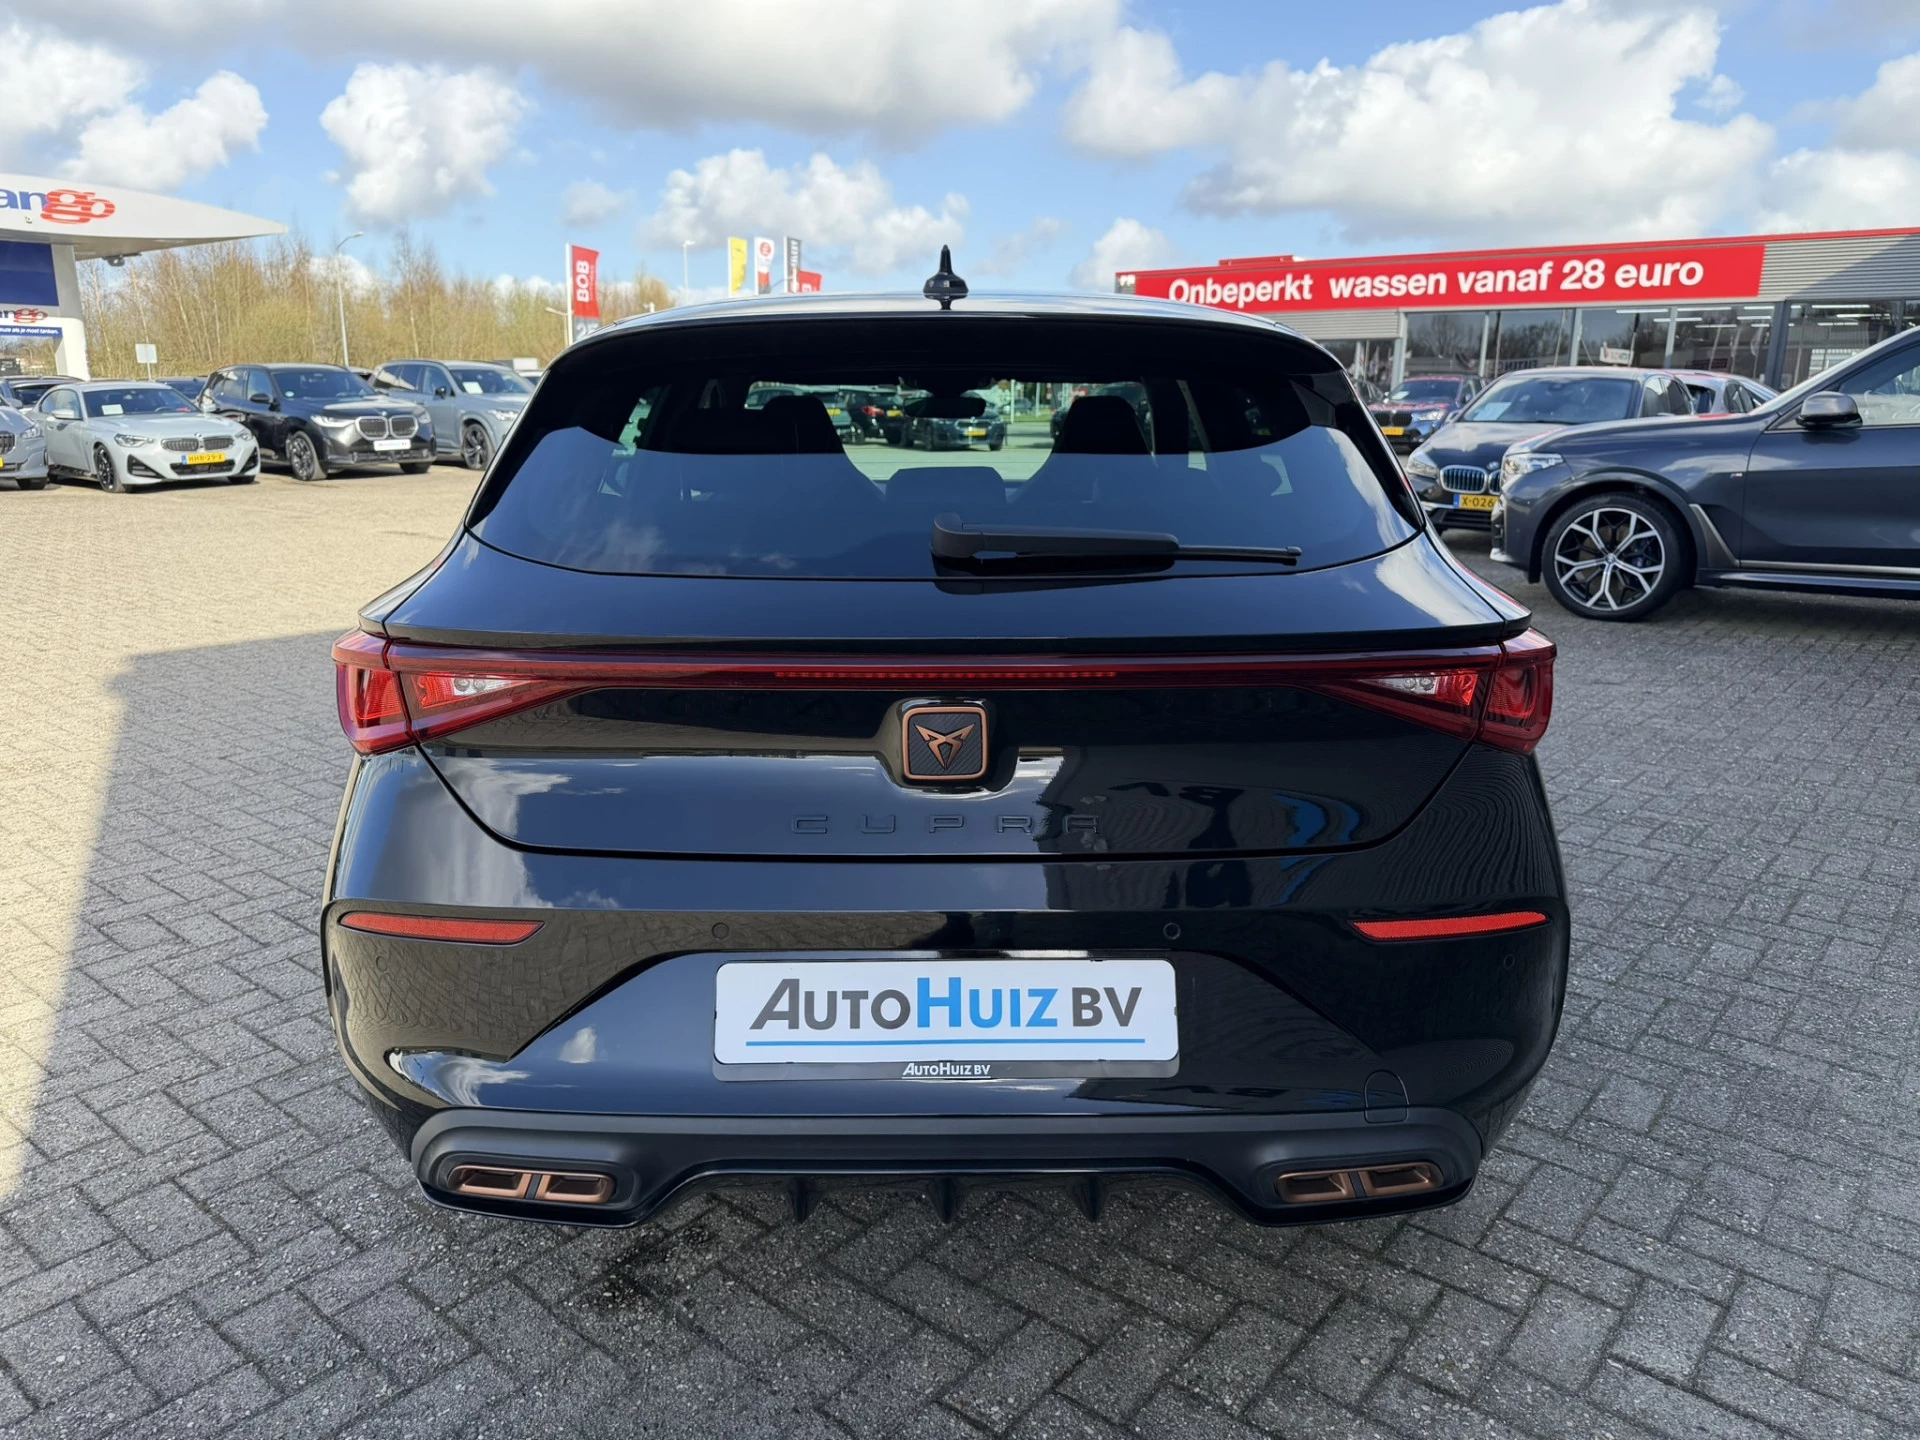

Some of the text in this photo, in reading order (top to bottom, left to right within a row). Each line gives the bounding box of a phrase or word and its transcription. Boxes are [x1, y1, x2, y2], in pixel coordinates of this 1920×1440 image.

[576, 260, 590, 303] BOB
[1168, 258, 1704, 309] Onbeperkt wassen vanaf 28 euro
[791, 815, 1099, 834] CUPRA
[1072, 986, 1143, 1028] BV
[974, 1064, 991, 1075] BV
